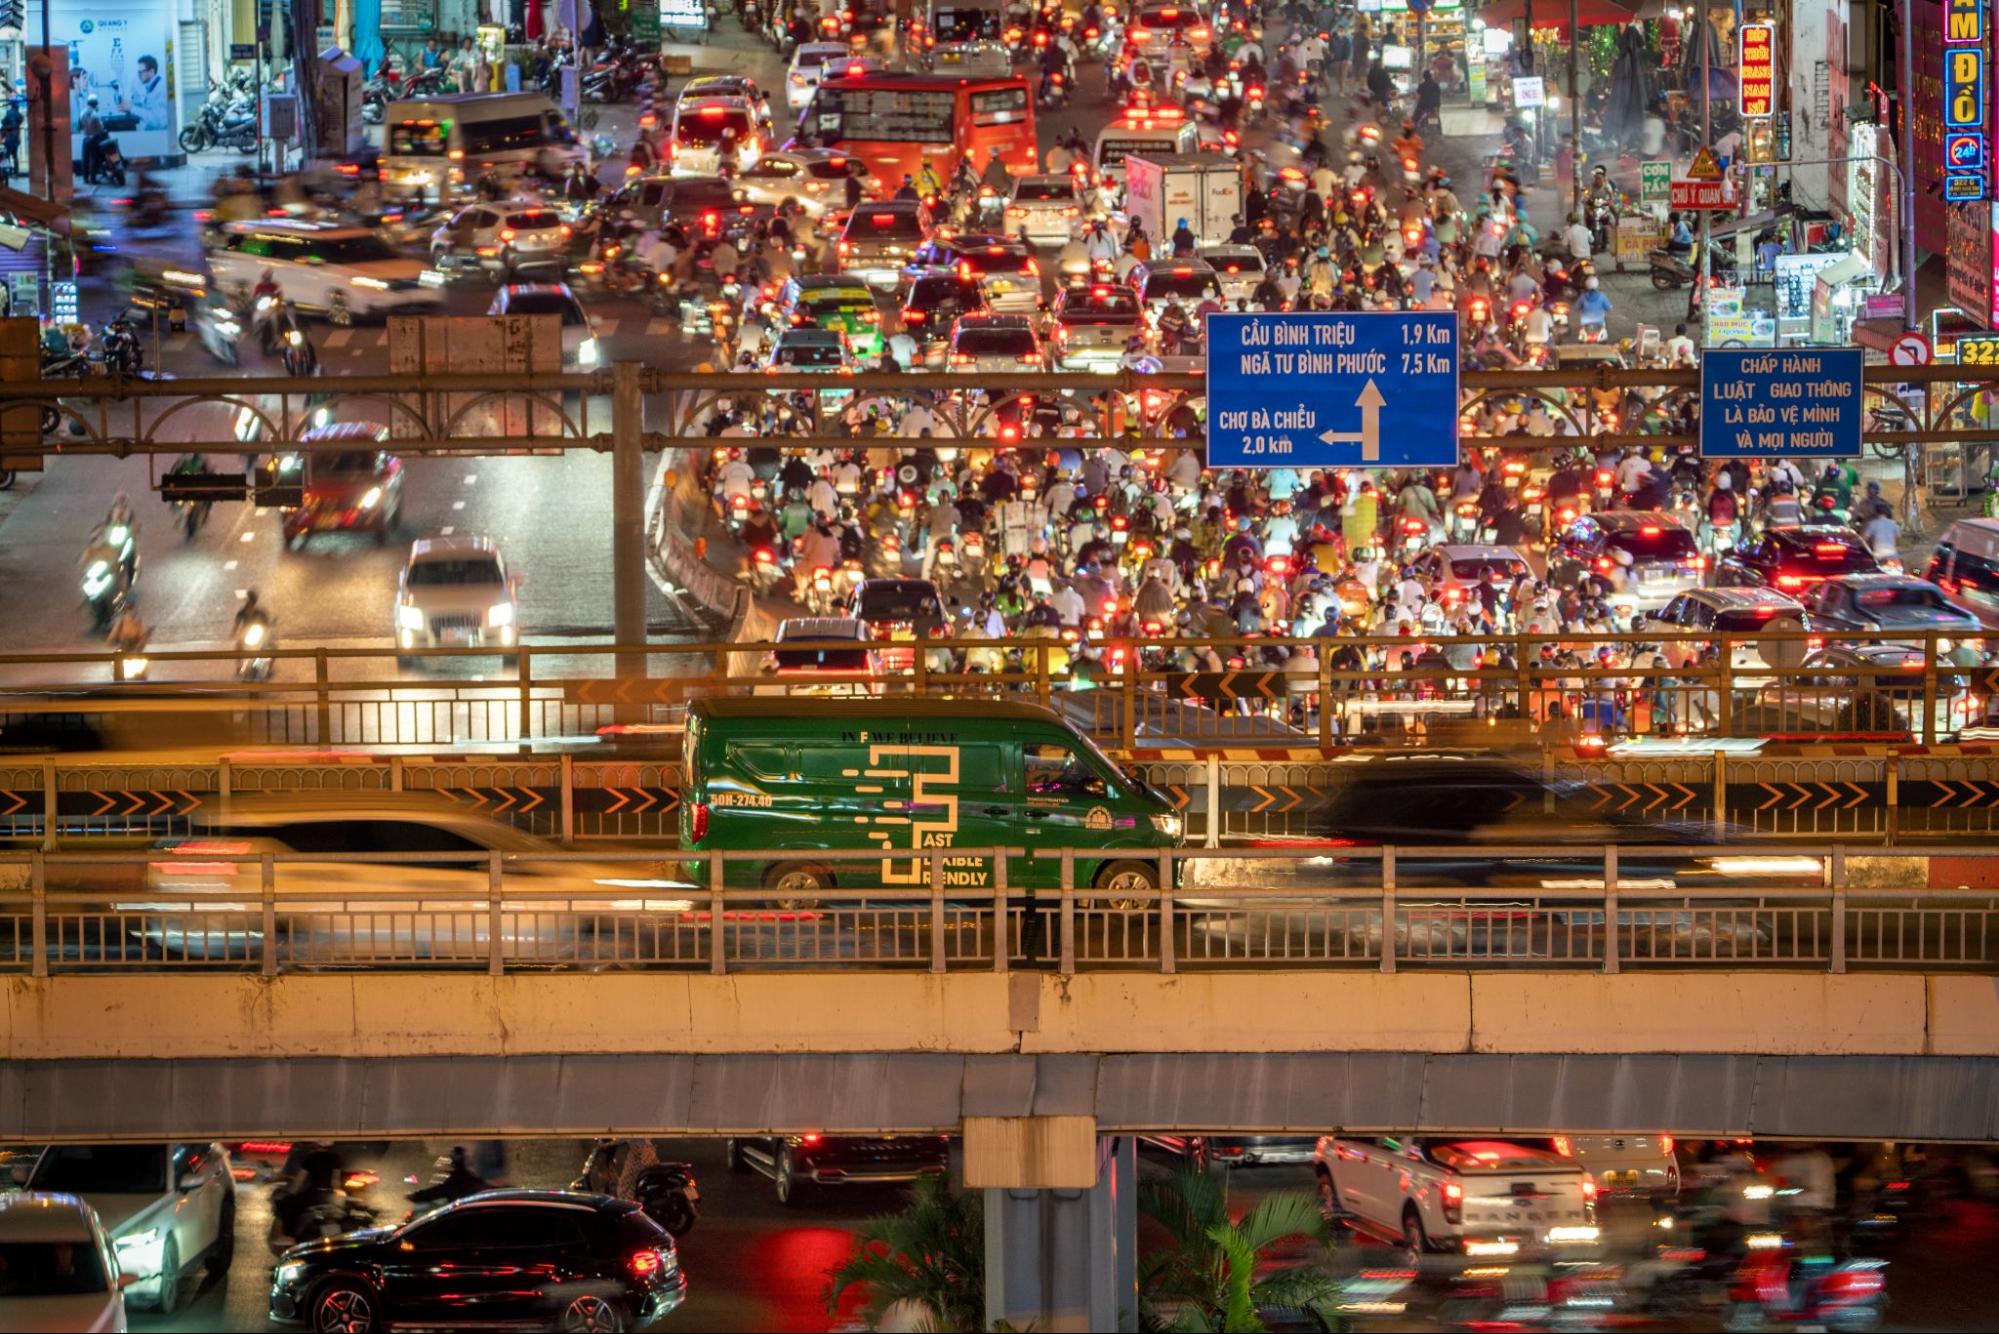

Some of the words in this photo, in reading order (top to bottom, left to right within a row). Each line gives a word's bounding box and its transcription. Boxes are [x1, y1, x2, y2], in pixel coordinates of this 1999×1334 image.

[1743, 84, 1770, 97] NAM
[1954, 52, 1977, 122] ĐỒ
[1954, 142, 1976, 158] 24h
[1672, 184, 1688, 204] CHÚ
[1690, 184, 1697, 204] Ý
[1699, 188, 1720, 204] QUAN
[1241, 319, 1270, 346] CẦU
[1274, 321, 1309, 345] BÌNH
[1313, 321, 1356, 348] TRIỆU
[1401, 324, 1423, 345] 1,9
[1426, 324, 1450, 344] Km
[1241, 351, 1271, 375] NGÃ
[1275, 353, 1294, 374] TƯ
[1298, 350, 1333, 374] BÌNH
[1337, 348, 1386, 374] PHƯỚC
[1401, 354, 1423, 375] 7,5
[1427, 354, 1450, 373] Km
[1740, 353, 1778, 374] CHẤP
[1782, 354, 1821, 373] HÀNH
[1713, 380, 1756, 402] LUẬT
[1770, 382, 1802, 398] GIAO
[1806, 379, 1852, 398] THÔNG
[1219, 411, 1247, 432] CHỢ
[1251, 408, 1270, 429] BÀ
[1274, 403, 1316, 431] CHIỂU
[1724, 404, 1743, 424] LÀ
[1748, 404, 1775, 423] BẢO
[1780, 405, 1799, 426] VỆ
[1803, 403, 1840, 423] MÌNH
[1242, 436, 1265, 454] 2,0
[1269, 436, 1293, 454] km
[1736, 429, 1753, 448] VÀ
[1758, 432, 1784, 451] MỌI
[1790, 428, 1833, 448] NGƯỜI
[842, 732, 856, 742] IN
[860, 731, 868, 744] F
[872, 733, 894, 743] WE
[899, 733, 959, 744] BELIEVE
[923, 833, 954, 847] AST
[923, 857, 983, 867] LXIBLE
[922, 871, 988, 886] RNDLY
[1465, 1211, 1584, 1222] RANGER
